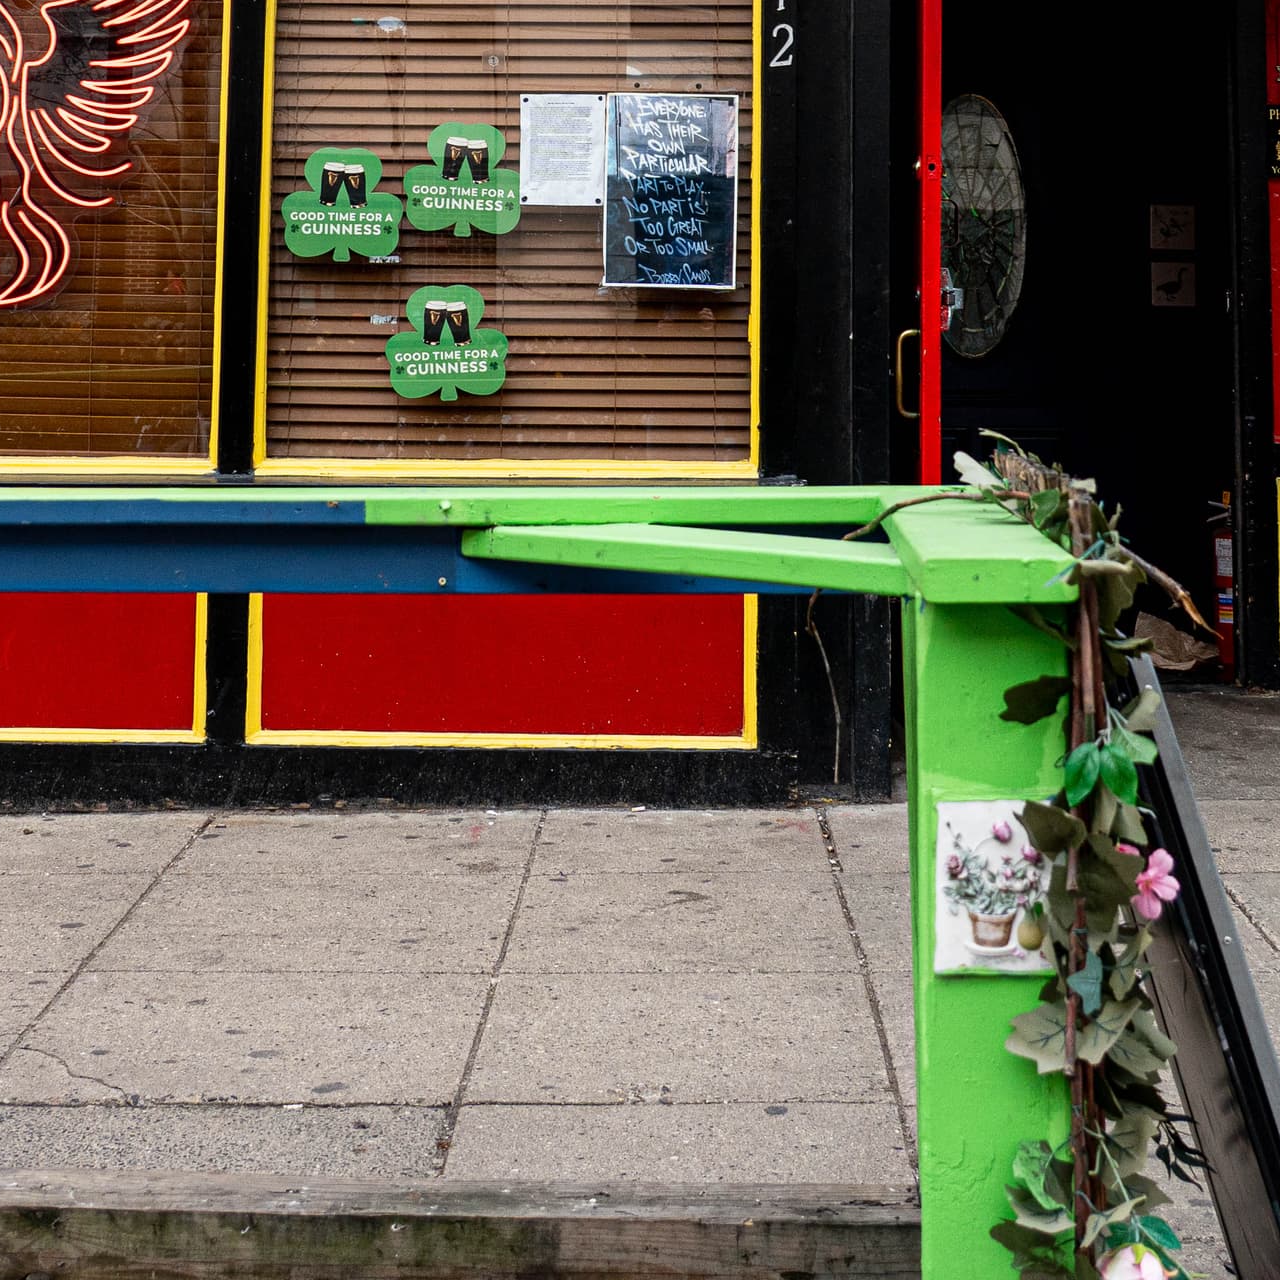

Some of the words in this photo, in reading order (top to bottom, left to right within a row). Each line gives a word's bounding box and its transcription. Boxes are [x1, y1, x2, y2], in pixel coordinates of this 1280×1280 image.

[626, 110, 663, 138] HAS
[647, 138, 686, 156] OWN
[620, 167, 661, 197] PART
[412, 185, 447, 195] GOOD
[449, 187, 478, 197] TIME
[481, 188, 505, 199] FOR
[506, 190, 515, 199] A
[422, 197, 503, 212] GUINNESS
[649, 198, 686, 217] PART
[290, 211, 325, 221] GOOD
[327, 212, 356, 222] TIME
[359, 212, 382, 222] FOR
[384, 213, 393, 222] A
[301, 223, 381, 236] GUINNESS
[394, 352, 430, 362] GOOD
[432, 350, 461, 361] TIME
[464, 349, 488, 359] FOR
[490, 349, 499, 358] A
[406, 361, 488, 376] GUINNESS
